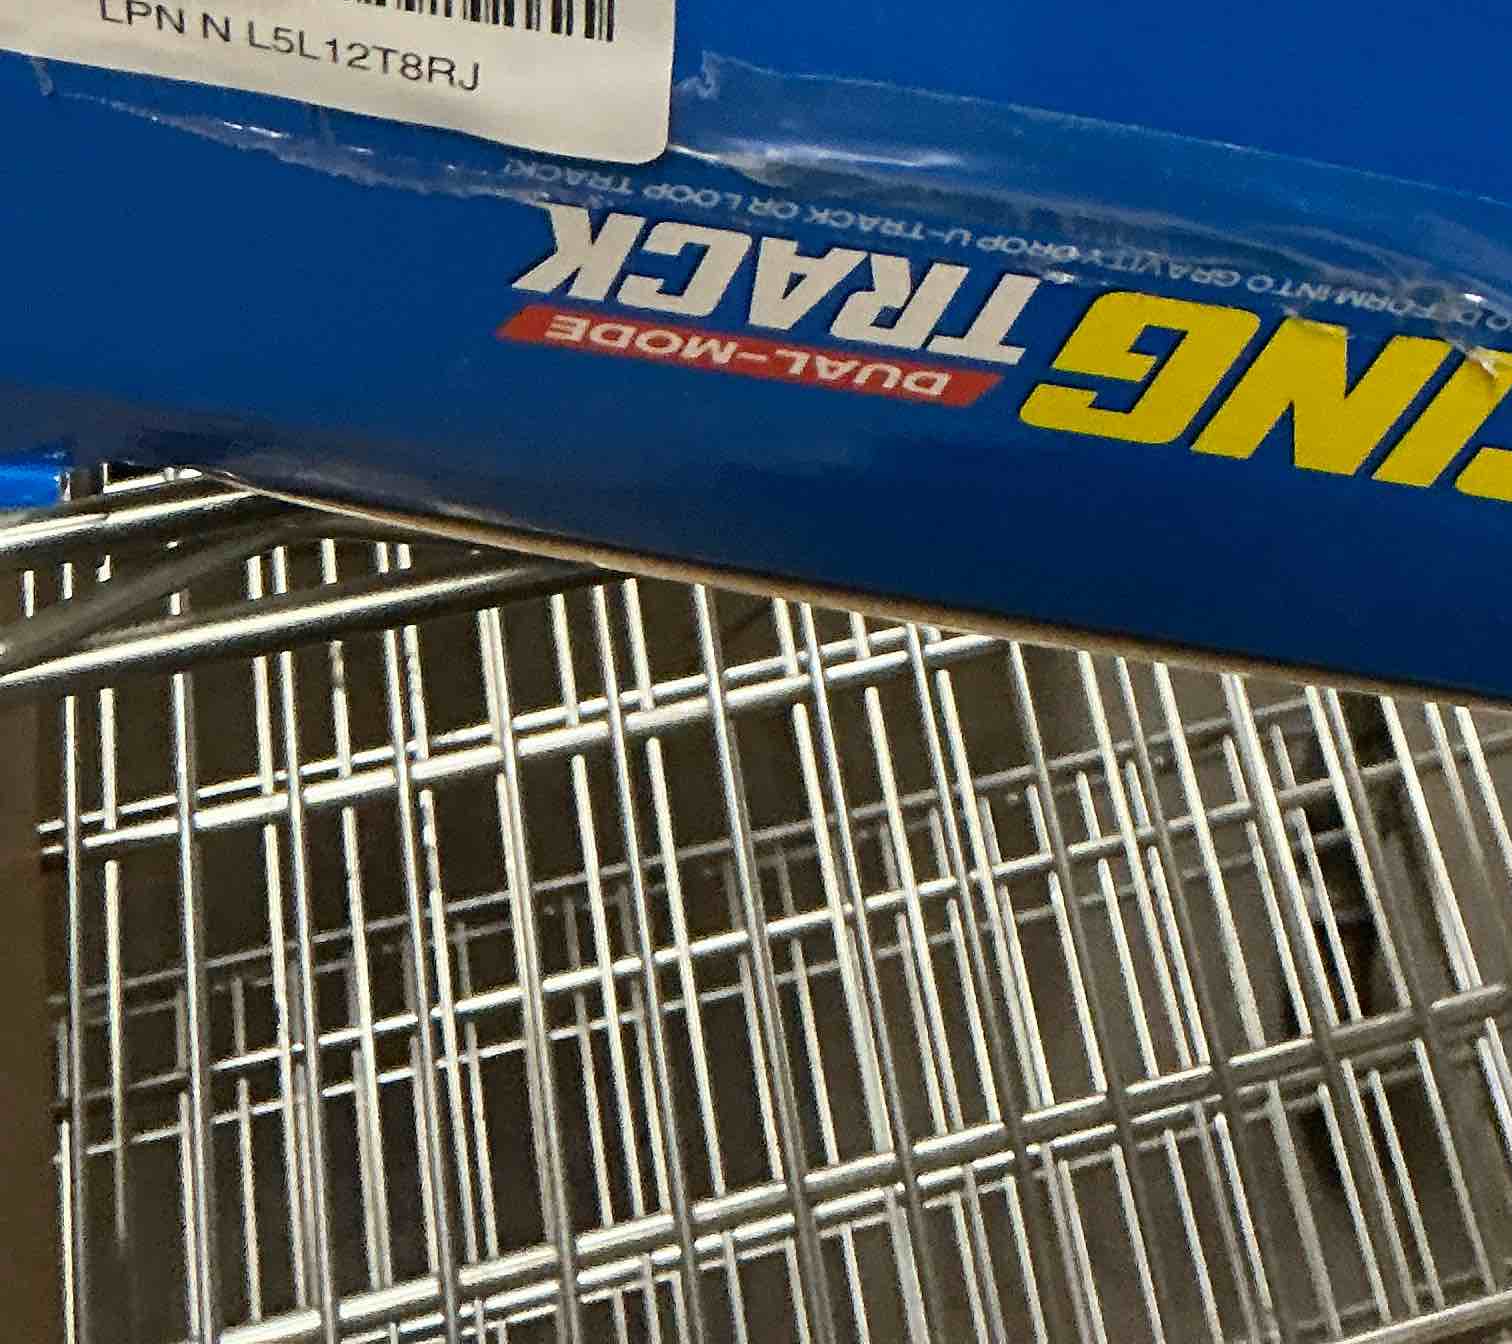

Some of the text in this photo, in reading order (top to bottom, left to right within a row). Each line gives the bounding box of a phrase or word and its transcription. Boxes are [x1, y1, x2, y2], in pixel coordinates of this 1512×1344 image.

[202, 12, 232, 43] N
[248, 20, 481, 92] L5L12T8RJ
[642, 183, 741, 209] LOOP
[747, 195, 799, 220] OR
[801, 205, 972, 247] U-TRACK
[511, 201, 1042, 366] TRACK
[543, 312, 953, 397] DUAL-MODE
